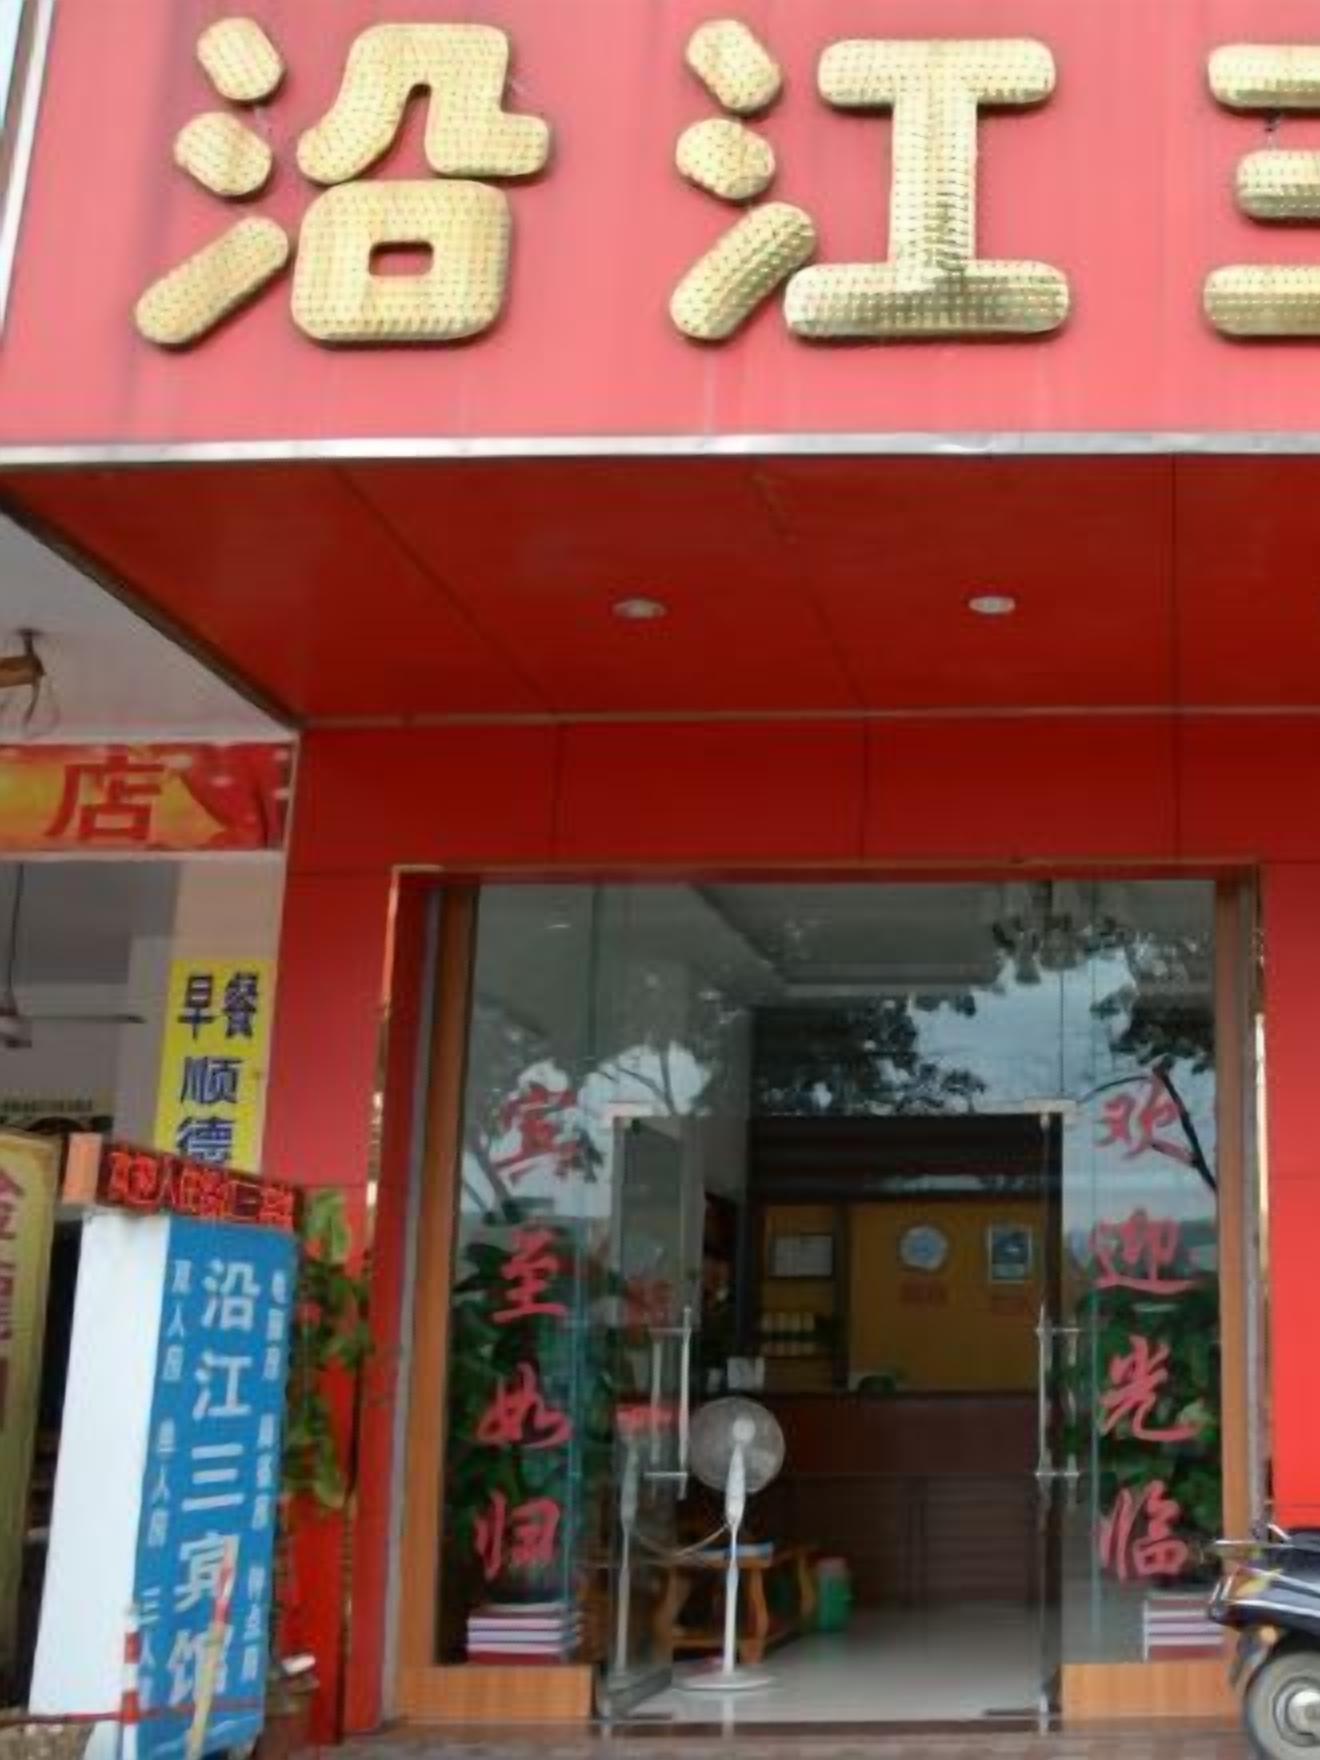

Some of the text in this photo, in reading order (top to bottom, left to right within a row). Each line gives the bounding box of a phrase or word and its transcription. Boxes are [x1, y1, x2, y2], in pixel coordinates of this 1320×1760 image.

[44, 755, 166, 842] 店
[177, 972, 259, 1040] 早餐
[1090, 1076, 1200, 1581] 欢迎光临
